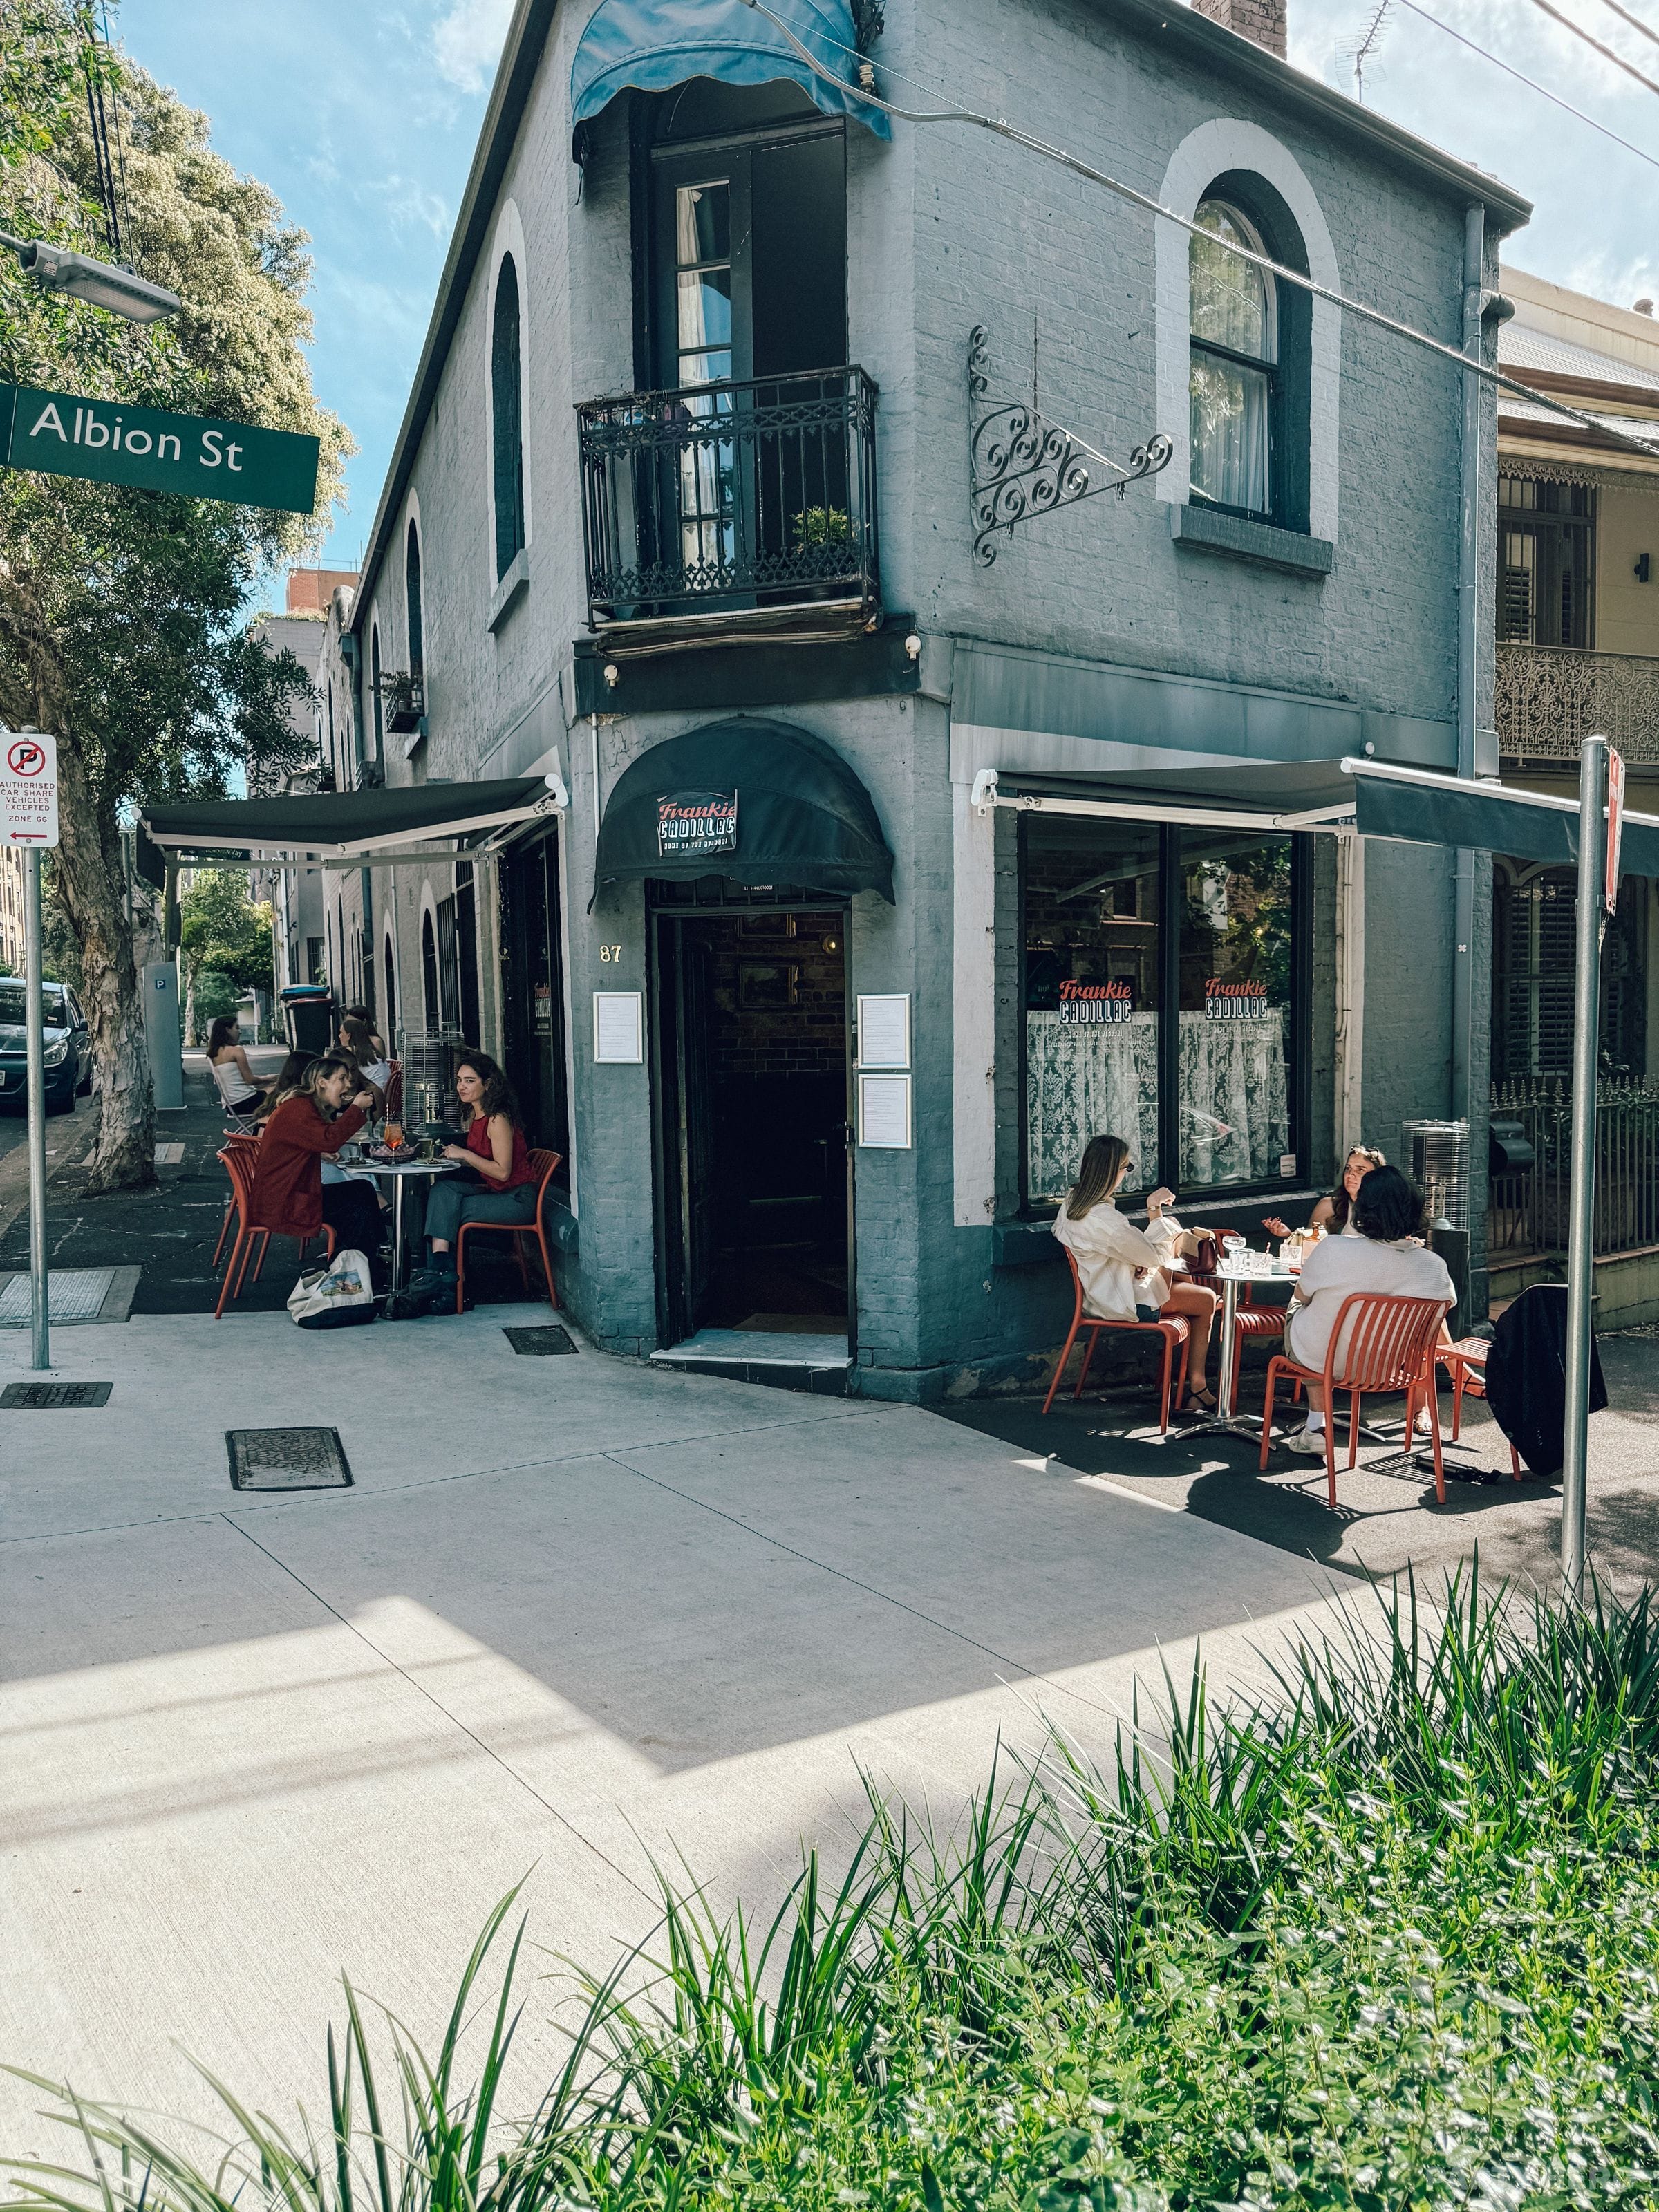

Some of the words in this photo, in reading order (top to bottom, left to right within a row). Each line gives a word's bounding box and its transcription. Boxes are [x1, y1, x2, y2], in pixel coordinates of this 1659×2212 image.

[29, 402, 181, 461] Albion
[199, 431, 243, 471] St
[659, 802, 735, 820] Frankie
[659, 816, 735, 839] CADILLAC
[599, 944, 622, 963] 87
[157, 980, 165, 988] P
[1059, 979, 1132, 1000] Frankie
[1205, 977, 1268, 997] Frankie
[1060, 1000, 1132, 1024] CADILLAC
[1205, 997, 1268, 1019] CADILLAC
